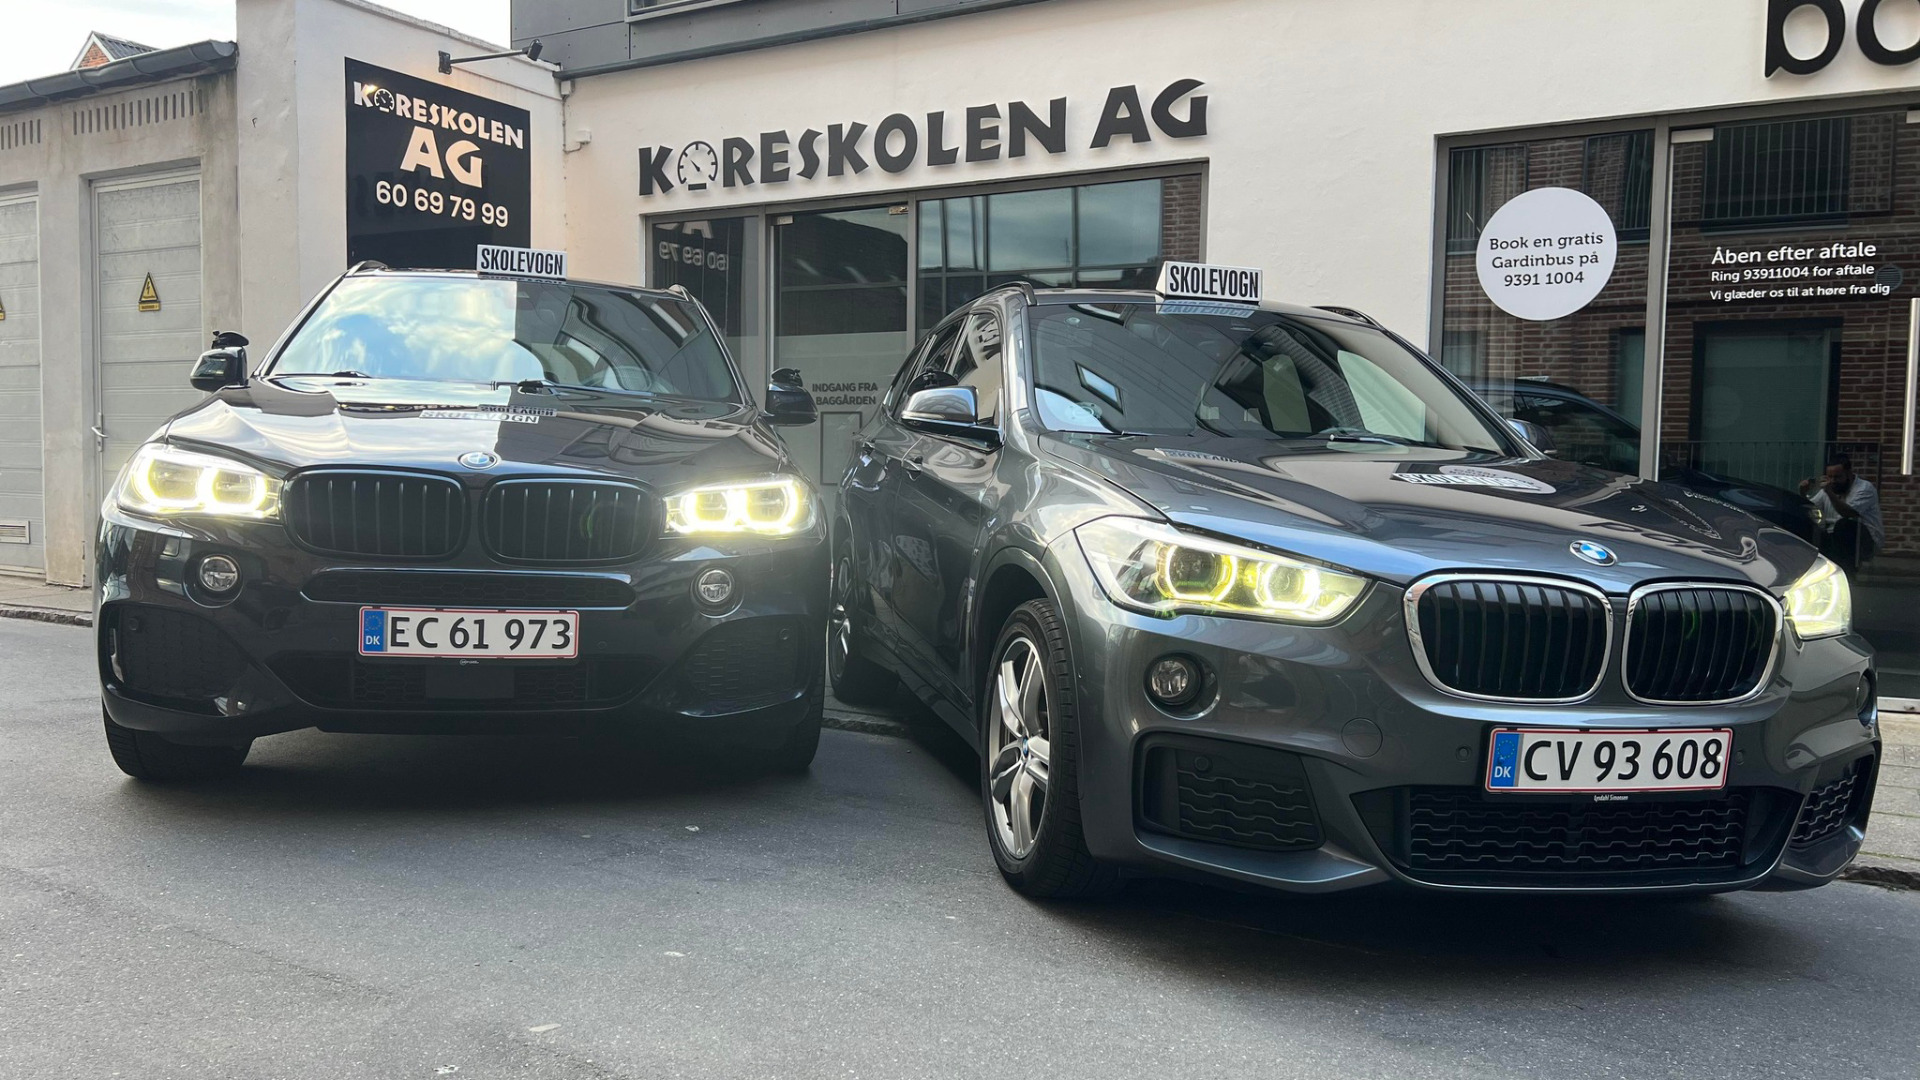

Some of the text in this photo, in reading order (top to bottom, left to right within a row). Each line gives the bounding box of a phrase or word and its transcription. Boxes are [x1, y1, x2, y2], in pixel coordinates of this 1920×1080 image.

[1089, 78, 1208, 149] AG
[400, 125, 483, 189] AG
[376, 180, 509, 228] 60 69 79 99
[1490, 232, 1604, 250] Book en gratis
[481, 248, 564, 276] SKOLEVOGN
[1491, 251, 1599, 269] Gardinbus på
[1711, 242, 1877, 265] Åben efter aftale
[1169, 265, 1259, 299] SKOLEVOGN
[1504, 271, 1585, 287] 9391 1004
[1711, 264, 1875, 283] Ring 93911004 for aftale
[1710, 283, 1890, 302] Vi glæder os til at høre fra dig
[812, 382, 878, 392] INDGANG FRA
[816, 394, 877, 405] BAGGÅRDEN
[365, 635, 380, 645] DK
[390, 616, 571, 651] EC 61 973
[1524, 738, 1723, 783] CV 93 608
[1494, 765, 1511, 778] DK
